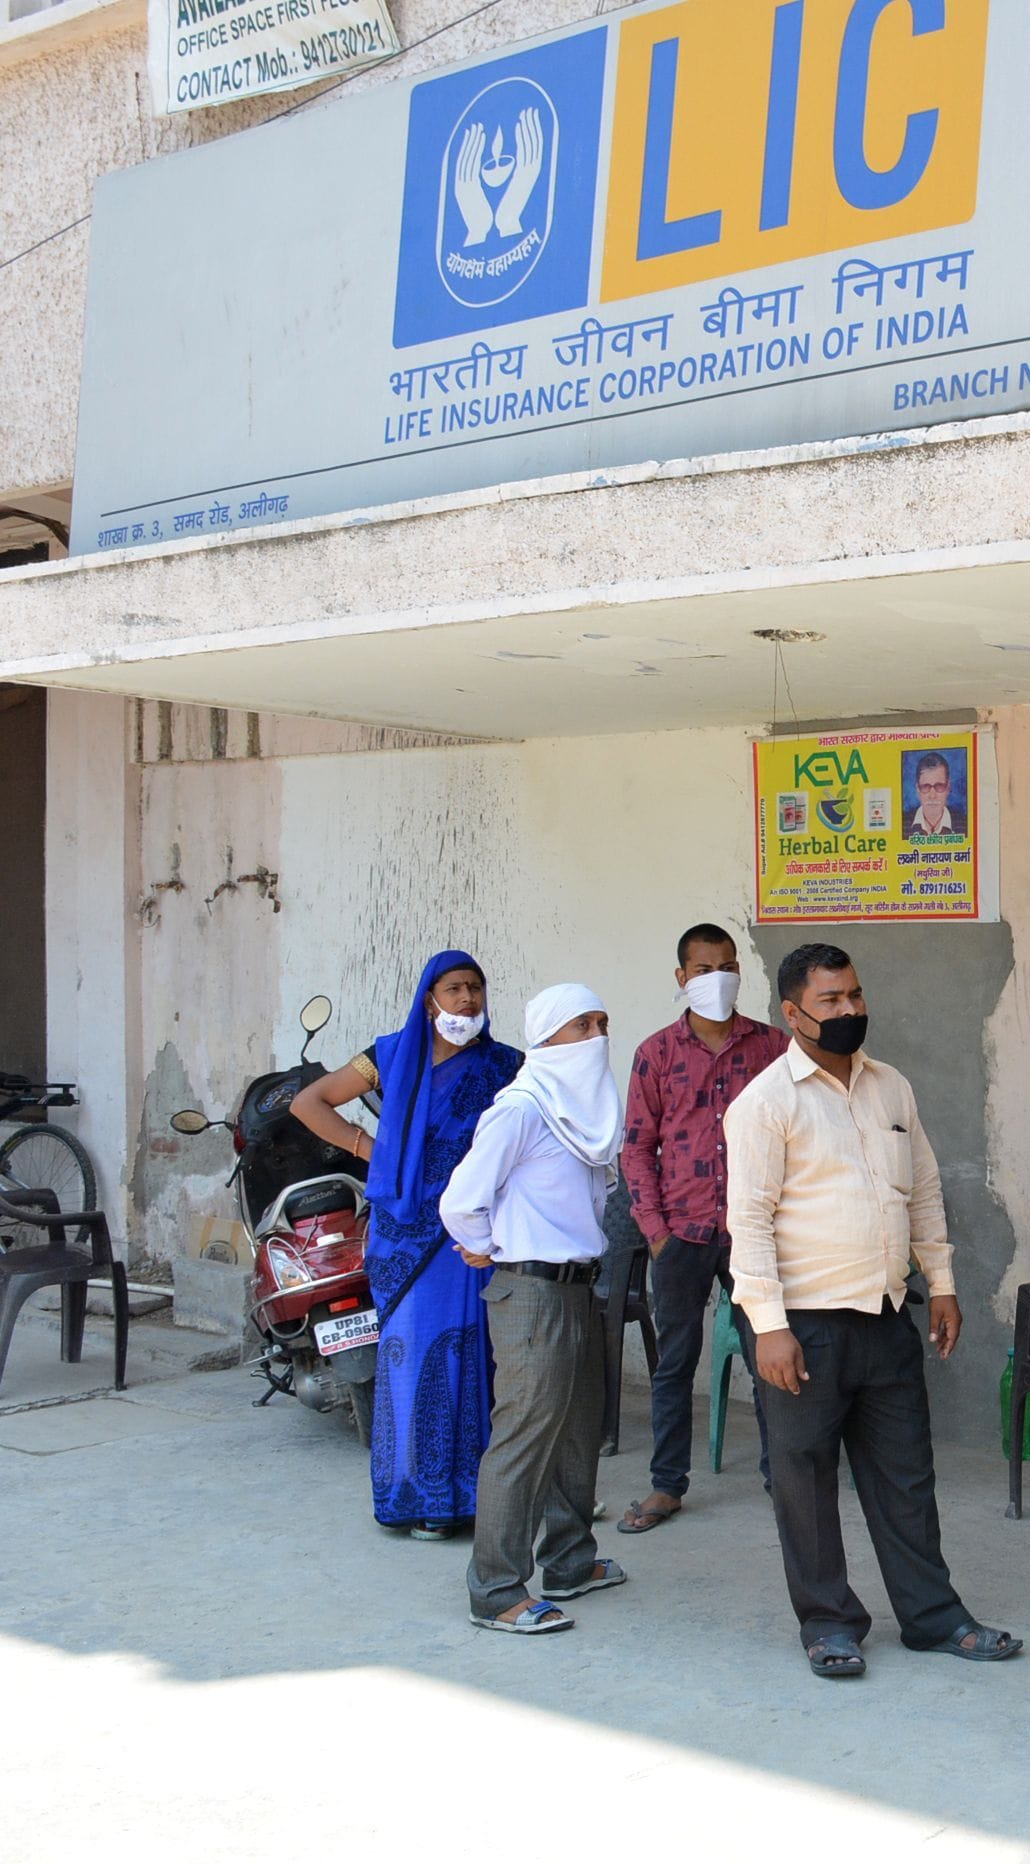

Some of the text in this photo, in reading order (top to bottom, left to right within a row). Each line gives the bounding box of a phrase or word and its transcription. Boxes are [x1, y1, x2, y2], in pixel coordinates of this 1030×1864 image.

[177, 0, 316, 57] OFFICE SPACE FIRST
[177, 58, 252, 103] CONTACT
[636, 0, 945, 262] LIC
[389, 250, 974, 402] भारतीय जीवन बीमा निगम
[384, 303, 969, 444] LIFE INSURANCE CORPORATION OF INDIA
[893, 365, 1009, 411] BRANCH
[98, 526, 129, 547] शाखा
[173, 511, 205, 532] समद
[238, 492, 290, 519] अलीगढ़
[794, 749, 869, 788] KEVA
[779, 834, 887, 856] Herbal Care
[921, 852, 952, 863] नारायण
[954, 847, 971, 863] वर्मा
[334, 1314, 369, 1331] UP81
